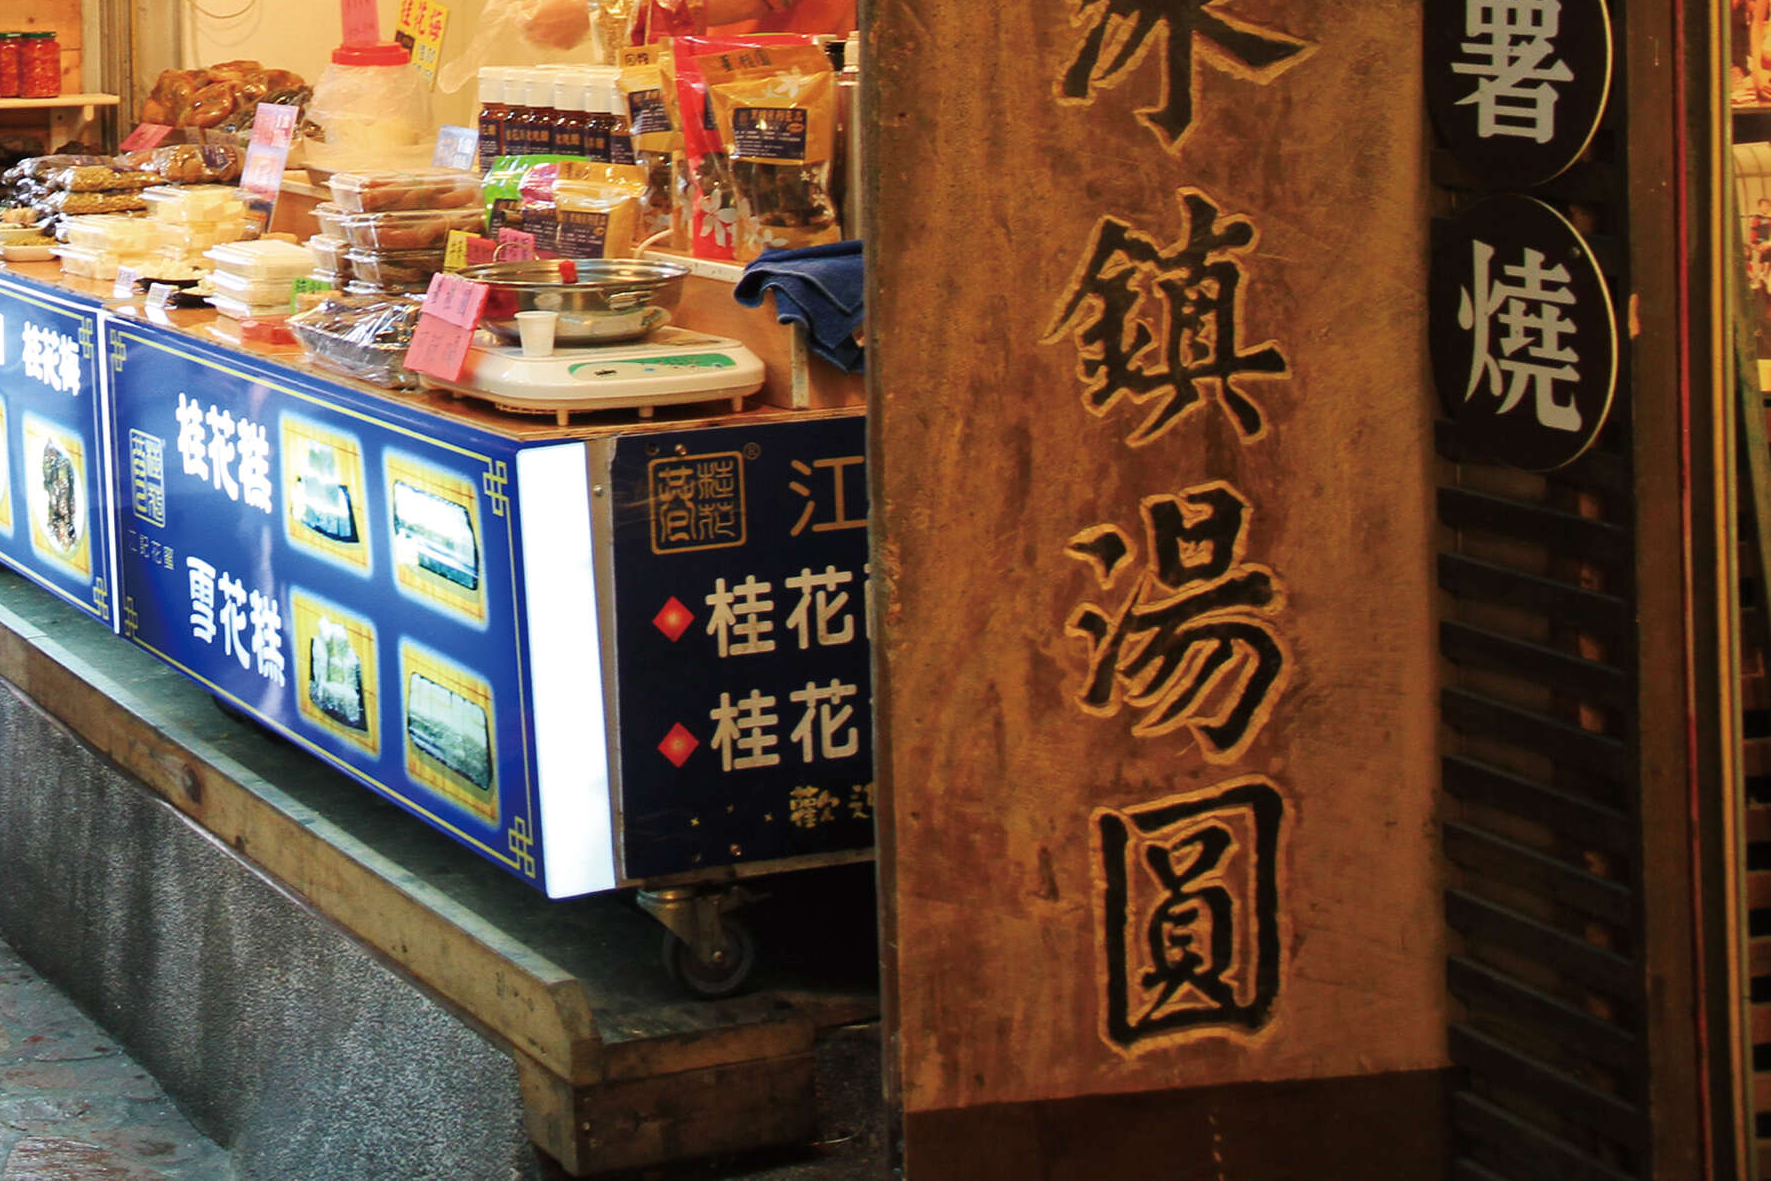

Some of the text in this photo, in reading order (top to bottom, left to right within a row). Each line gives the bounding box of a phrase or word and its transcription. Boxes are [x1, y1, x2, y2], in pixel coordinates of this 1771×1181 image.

[176, 392, 273, 514] 桂花糕
[186, 556, 286, 687] 雪花糕
[705, 563, 872, 659] 桂花
